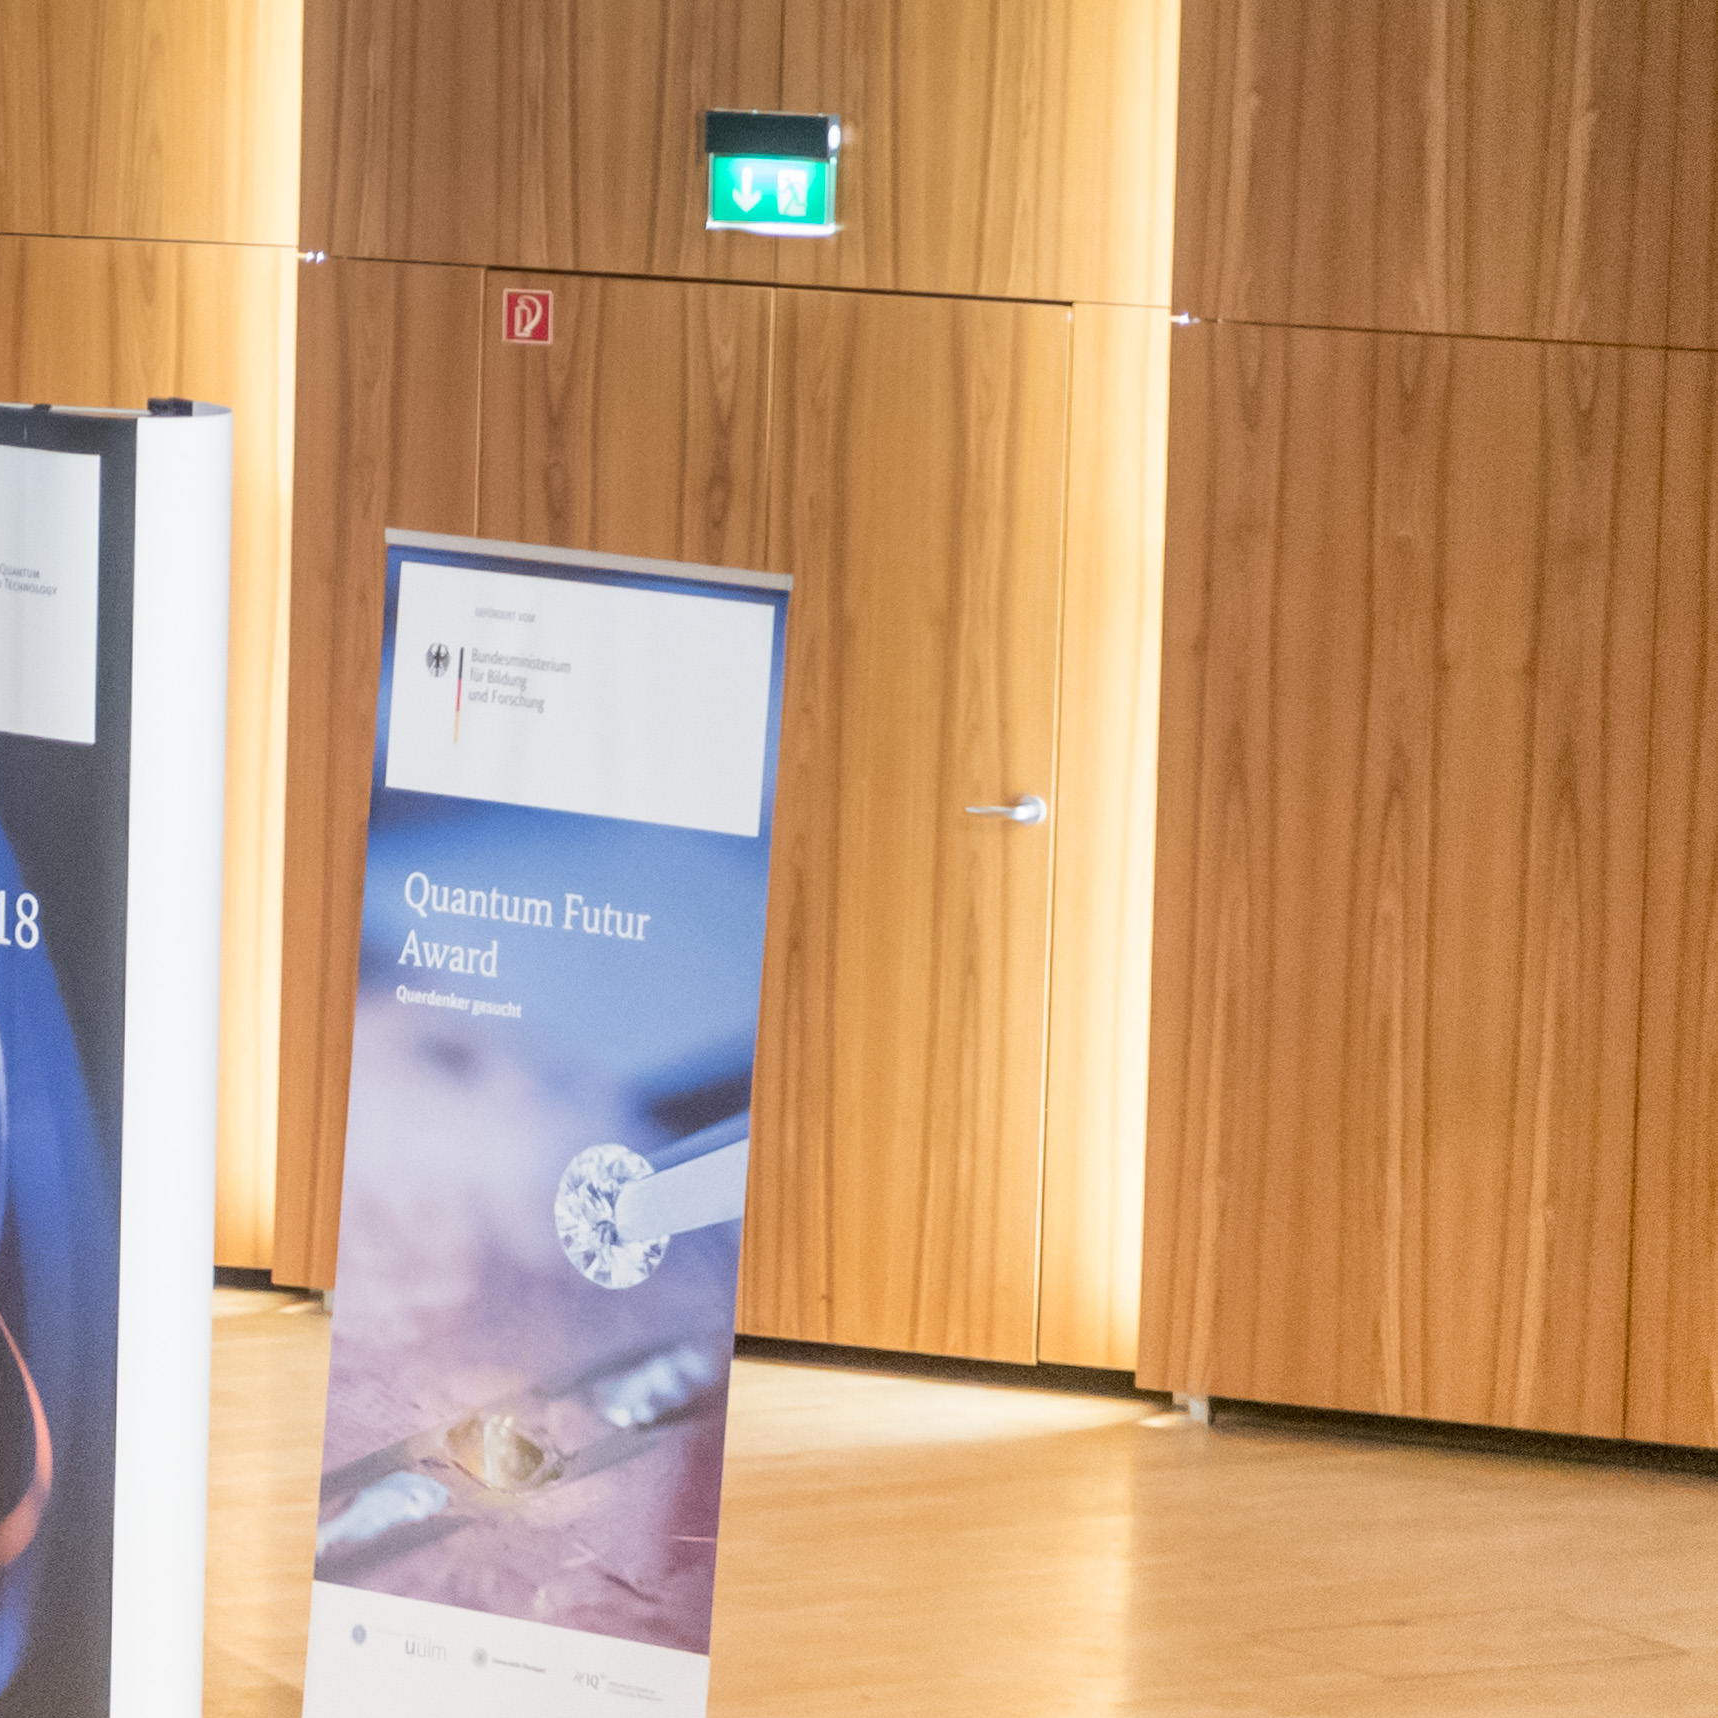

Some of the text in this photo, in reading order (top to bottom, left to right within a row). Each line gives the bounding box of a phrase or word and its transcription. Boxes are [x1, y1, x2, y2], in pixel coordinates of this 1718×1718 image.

[471, 648, 571, 674] Bundesministerium
[469, 667, 527, 691] für Bildung
[468, 689, 545, 714] und Forschung
[403, 871, 651, 941] Quantum Futur
[398, 930, 499, 978] Award
[396, 984, 522, 1019] Querdenker gesucht
